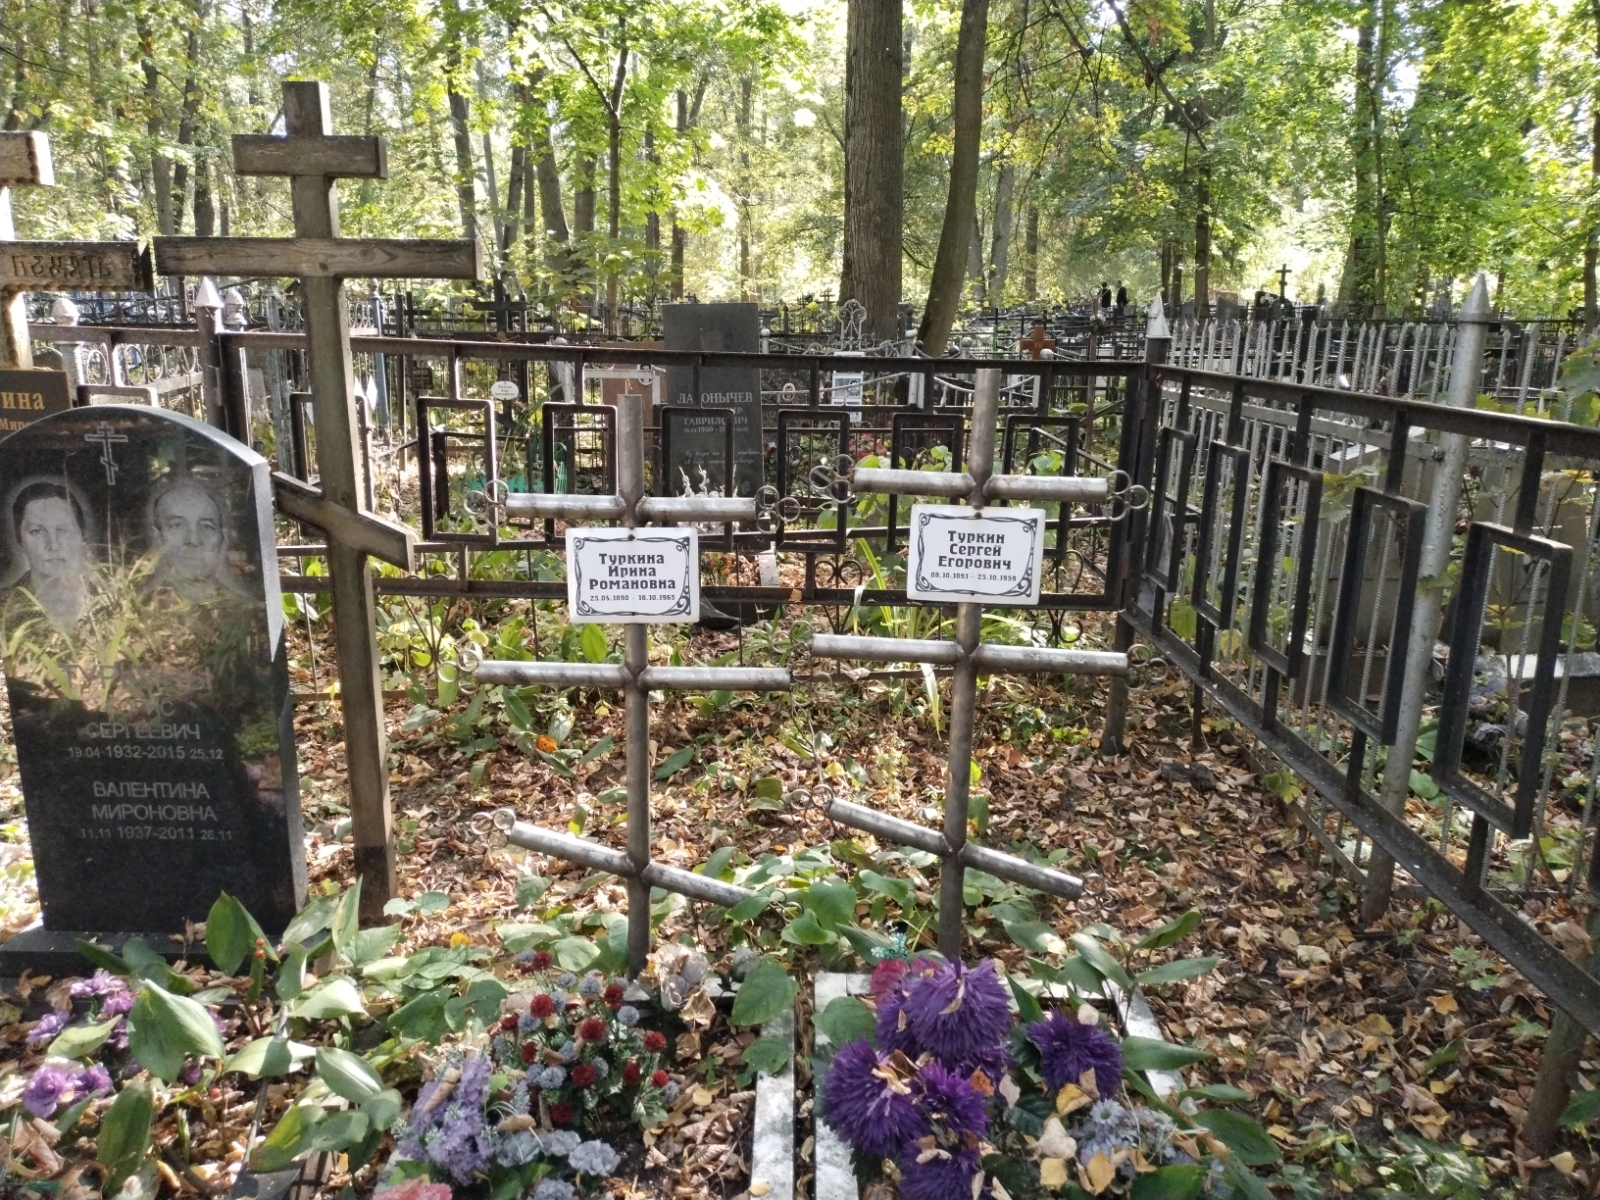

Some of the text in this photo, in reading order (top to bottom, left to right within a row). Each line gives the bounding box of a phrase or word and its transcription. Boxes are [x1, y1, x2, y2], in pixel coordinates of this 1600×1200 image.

[677, 391, 753, 404] ЛАОНЫЧЕВ
[683, 416, 748, 426] ГАВРИЛОИЧ
[948, 530, 1005, 544] Туркин
[949, 543, 1002, 557] Сергей
[599, 553, 665, 565] Туркина
[938, 555, 1012, 570] Егорович
[608, 565, 657, 577] Ирина
[977, 573, 1017, 582] 25.10.1959
[589, 578, 676, 590] Романовна
[86, 721, 201, 740] СЕРГЕЕВИЧ
[106, 745, 186, 759] 1932-2015
[189, 748, 224, 760] 25.12
[93, 781, 211, 799] ВАЛЕНТИНА
[91, 803, 218, 822] МИРОНОВНА
[79, 828, 111, 838] 11.11
[117, 826, 194, 840] 1937-2011
